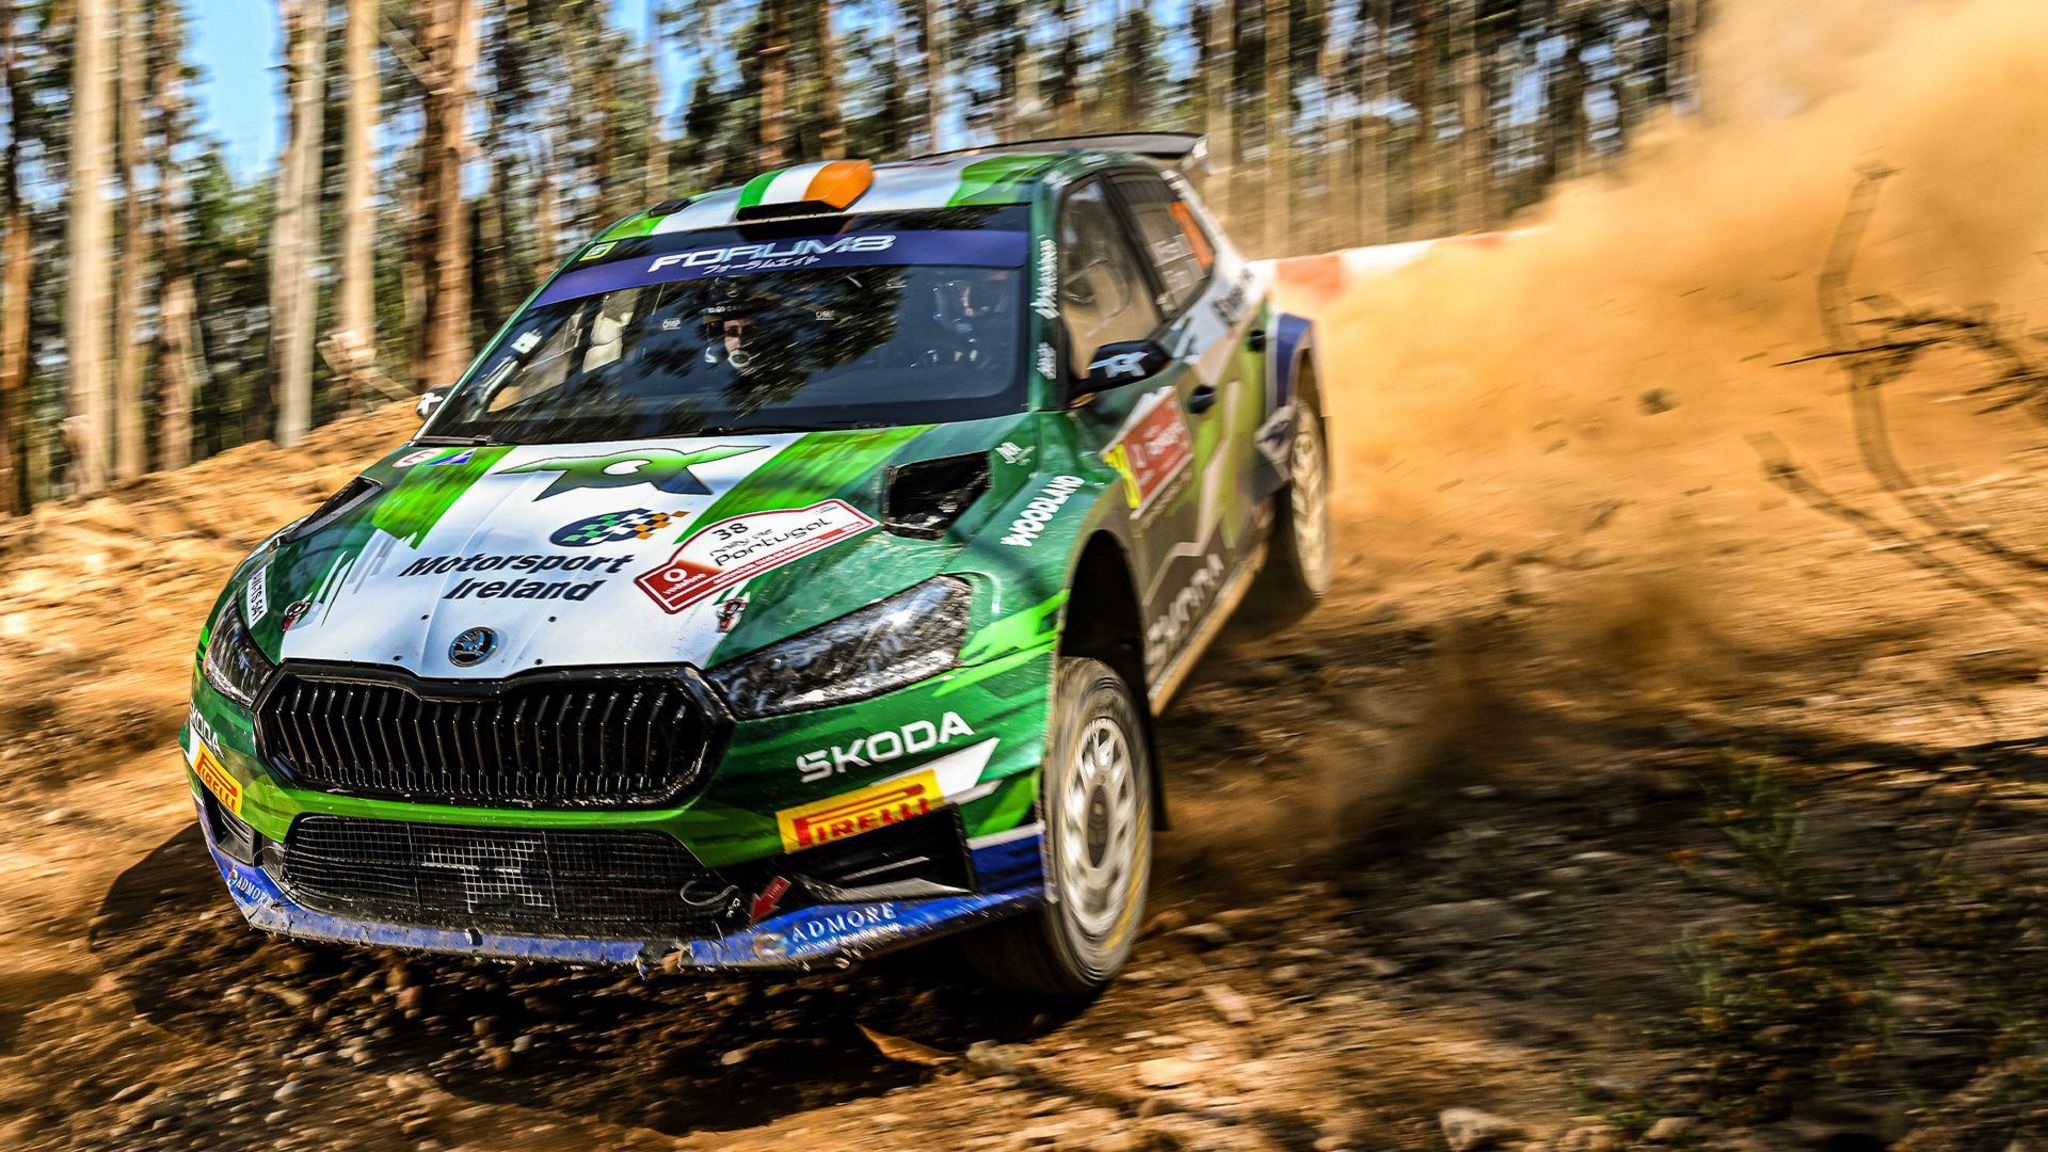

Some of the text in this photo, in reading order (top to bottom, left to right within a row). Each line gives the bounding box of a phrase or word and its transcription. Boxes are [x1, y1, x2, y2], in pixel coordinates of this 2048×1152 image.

[647, 235, 897, 272] FORUM8
[710, 522, 749, 541] 38
[1000, 475, 1085, 547] WOODLAND
[400, 553, 635, 577] Motorsport
[714, 518, 832, 567] Portugal
[443, 577, 606, 601] Ireland
[796, 711, 976, 783] SKODA
[196, 752, 238, 813] PIRELLI
[792, 784, 931, 847] PIRELLI
[791, 902, 897, 943] ADMORE
